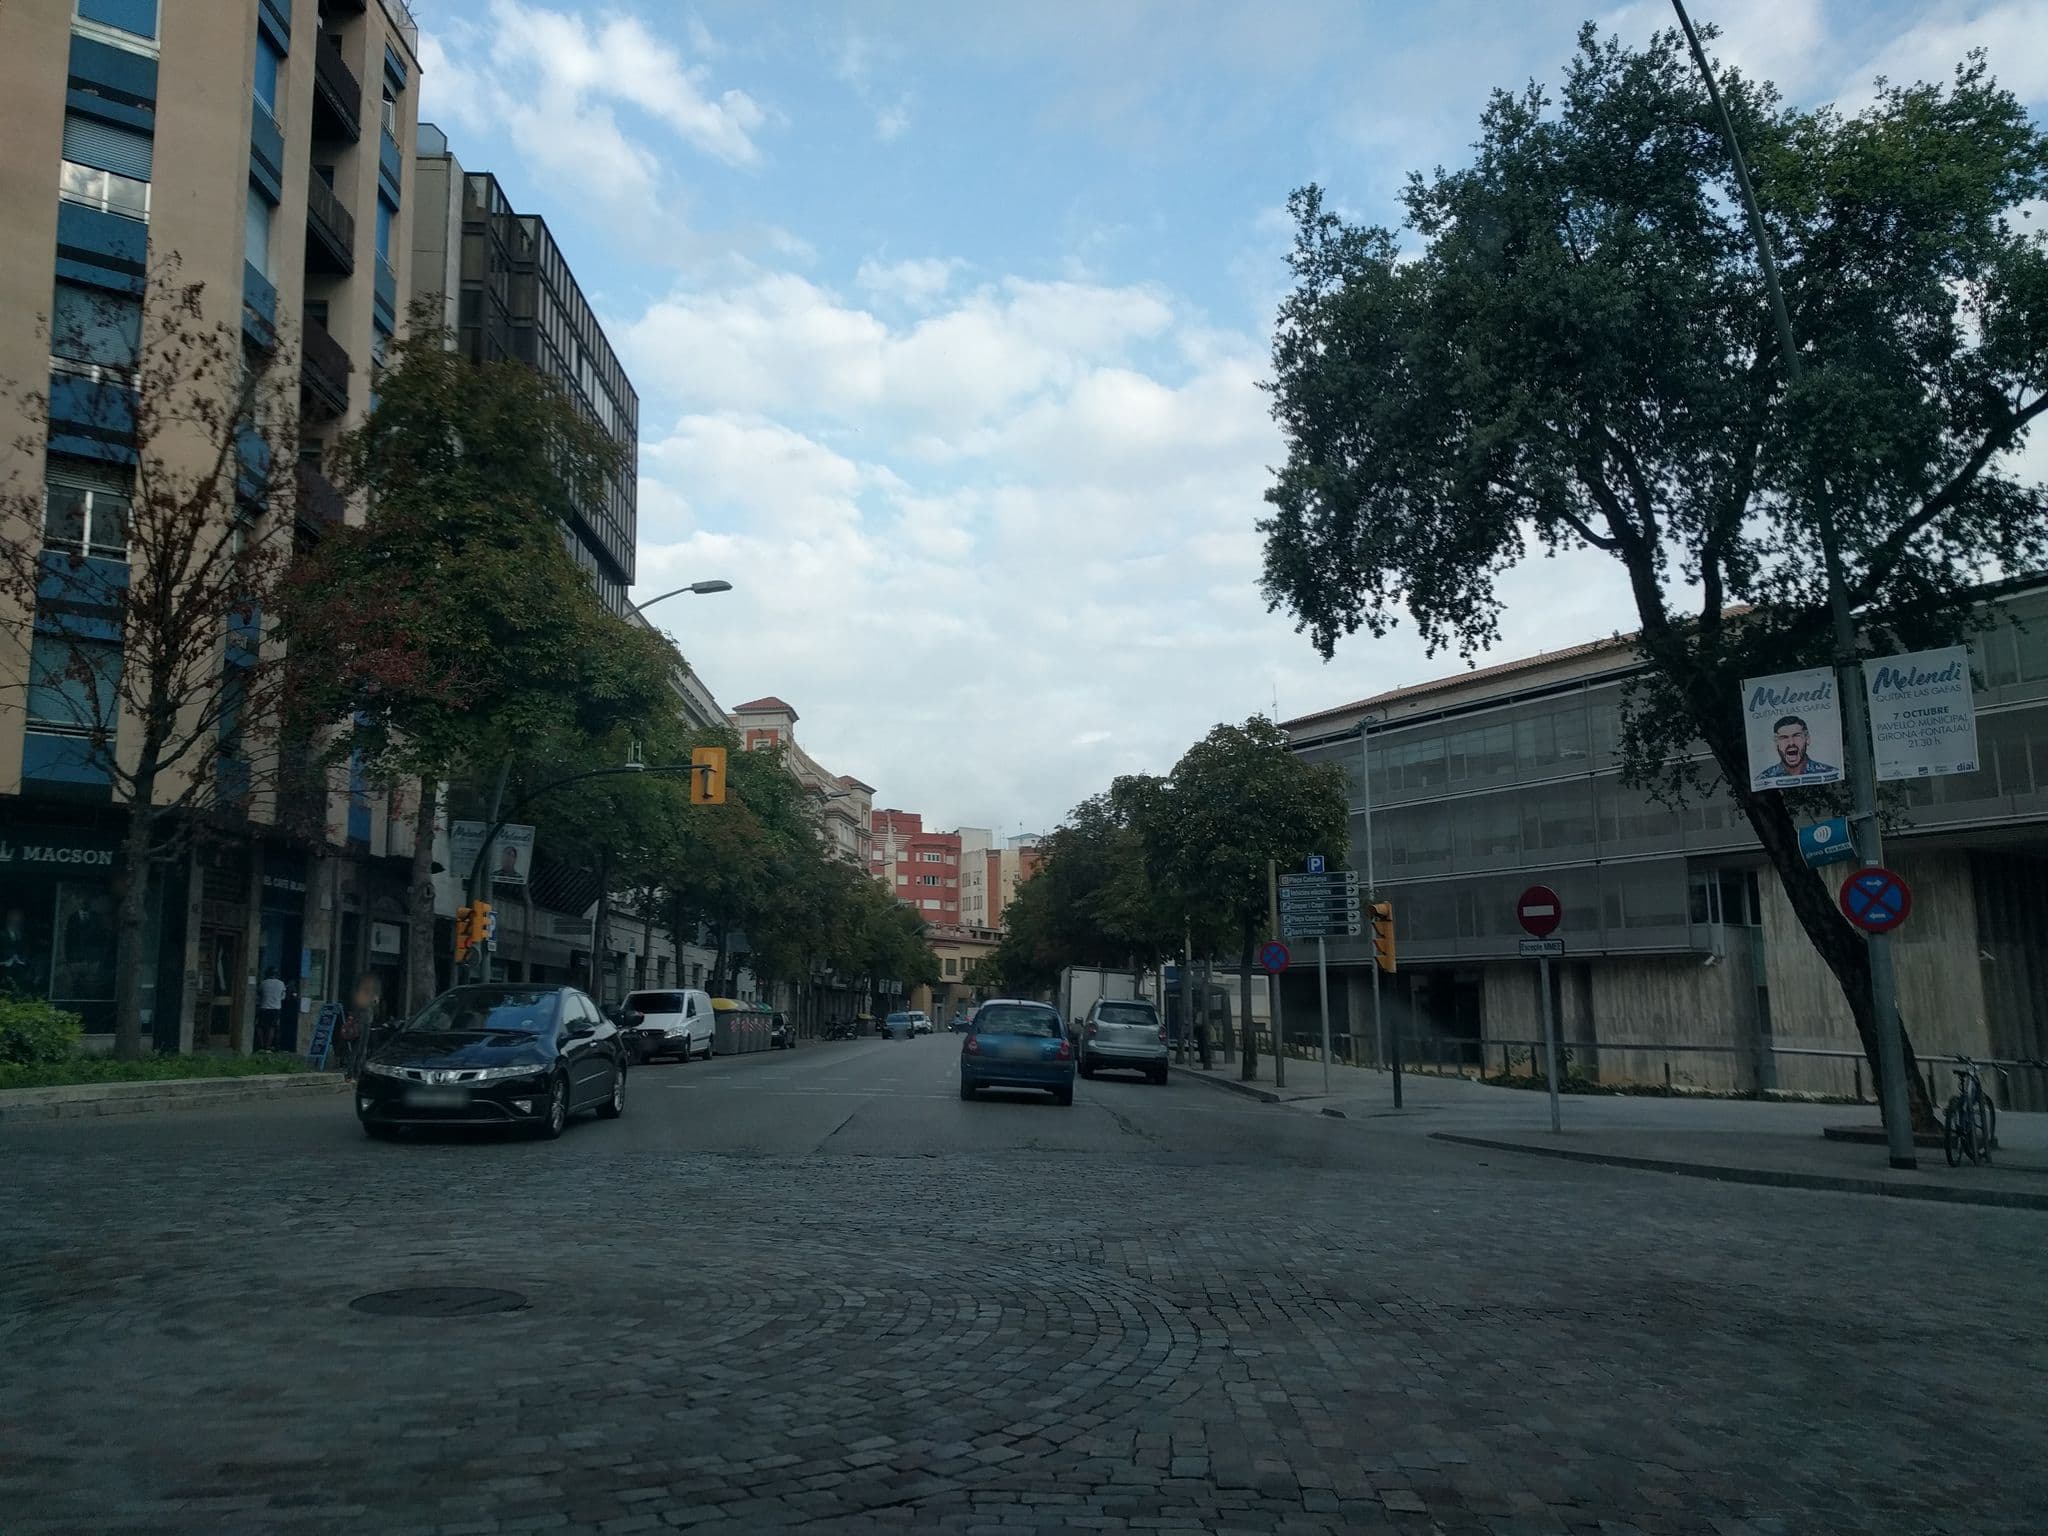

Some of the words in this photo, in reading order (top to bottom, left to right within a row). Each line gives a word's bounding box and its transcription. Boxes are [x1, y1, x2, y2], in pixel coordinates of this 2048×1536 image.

[1873, 661, 1962, 695] Melendi
[1749, 681, 1833, 712] Melendi
[1914, 687, 1930, 698] LAS
[1786, 704, 1801, 715] LAS
[1893, 712, 1899, 721] 7
[1903, 705, 1950, 719] OCTUBRE
[1918, 712, 1970, 728] MUNICIPAL
[1956, 761, 1975, 773] dial
[22, 846, 113, 865] MACSON
[1311, 858, 1321, 871] P
